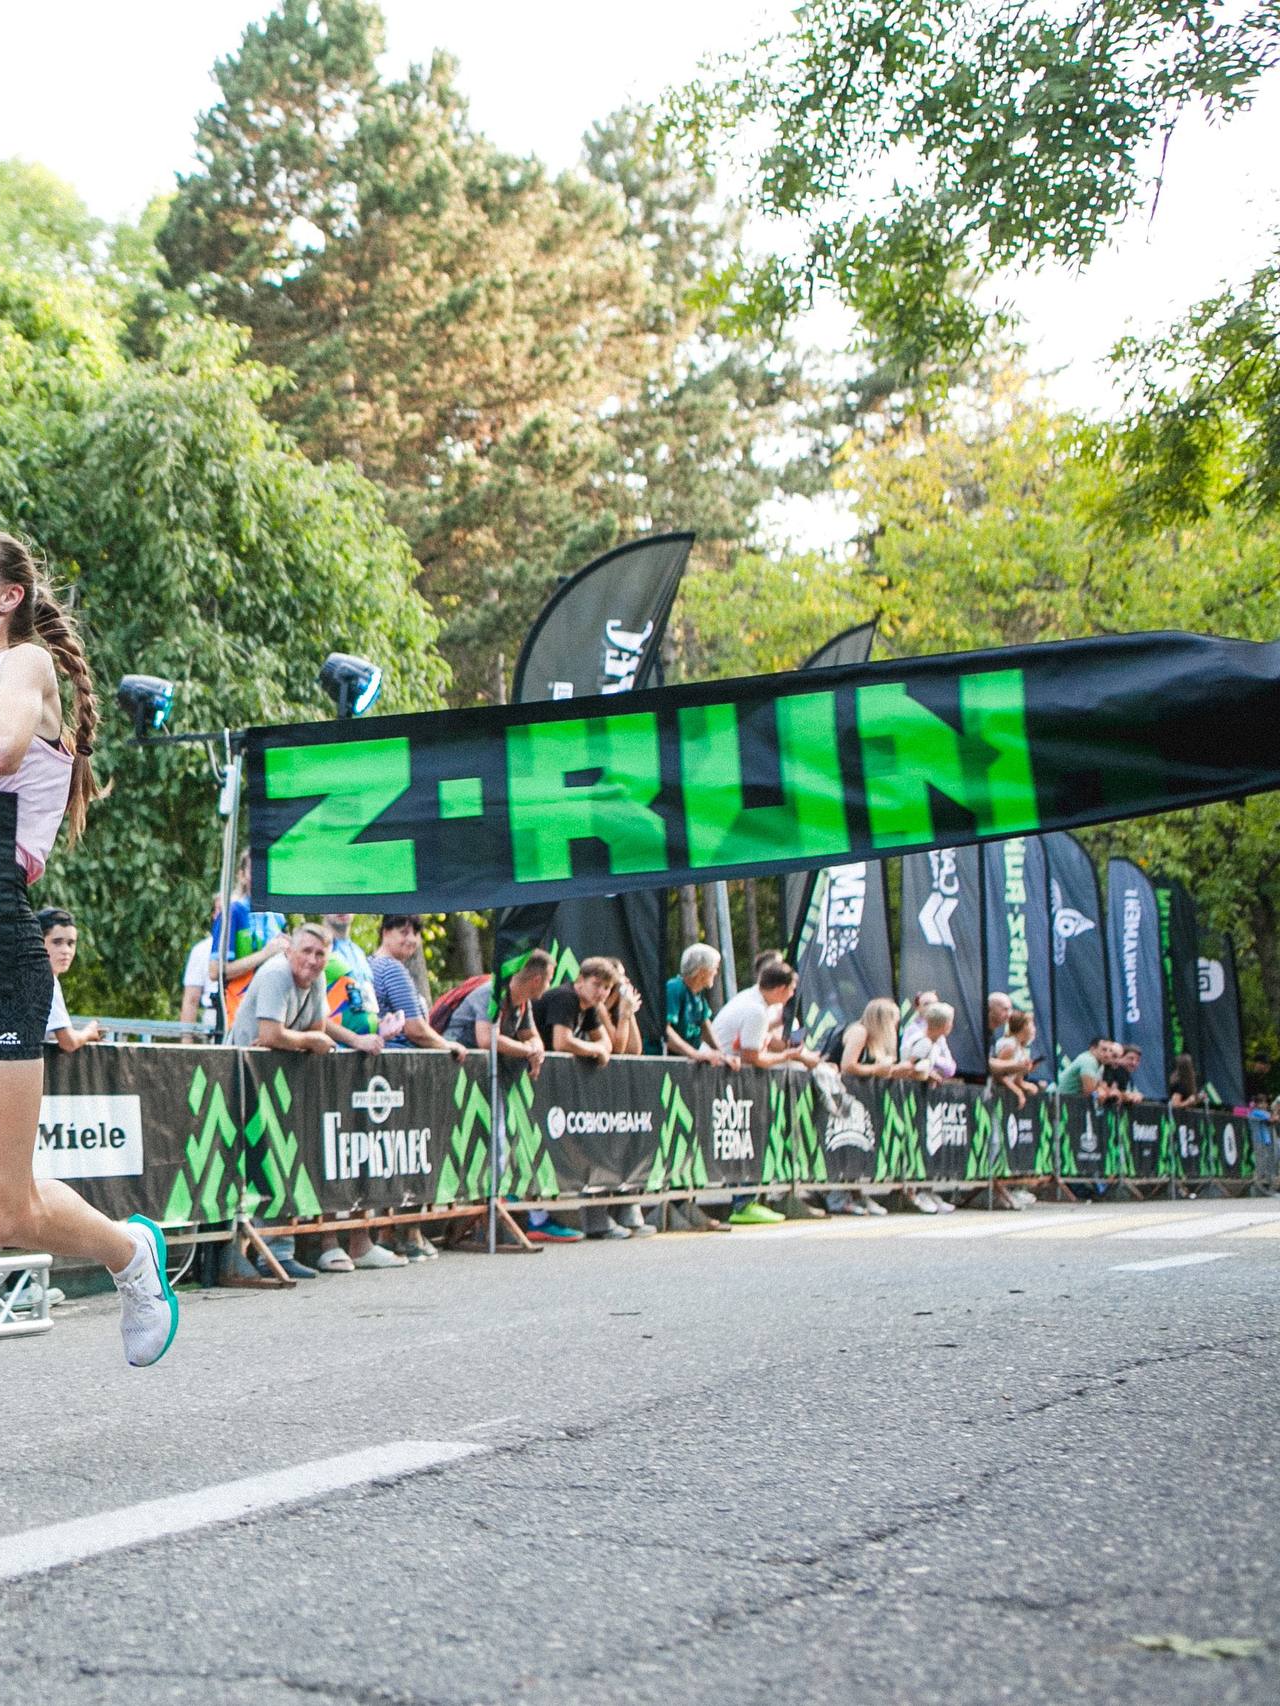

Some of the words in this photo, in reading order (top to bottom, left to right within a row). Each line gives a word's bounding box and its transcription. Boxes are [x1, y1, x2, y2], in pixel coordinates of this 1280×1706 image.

[265, 669, 1041, 896] Z-RUN
[39, 1122, 126, 1150] Miele
[566, 1110, 653, 1134] СОВКОМБАНК
